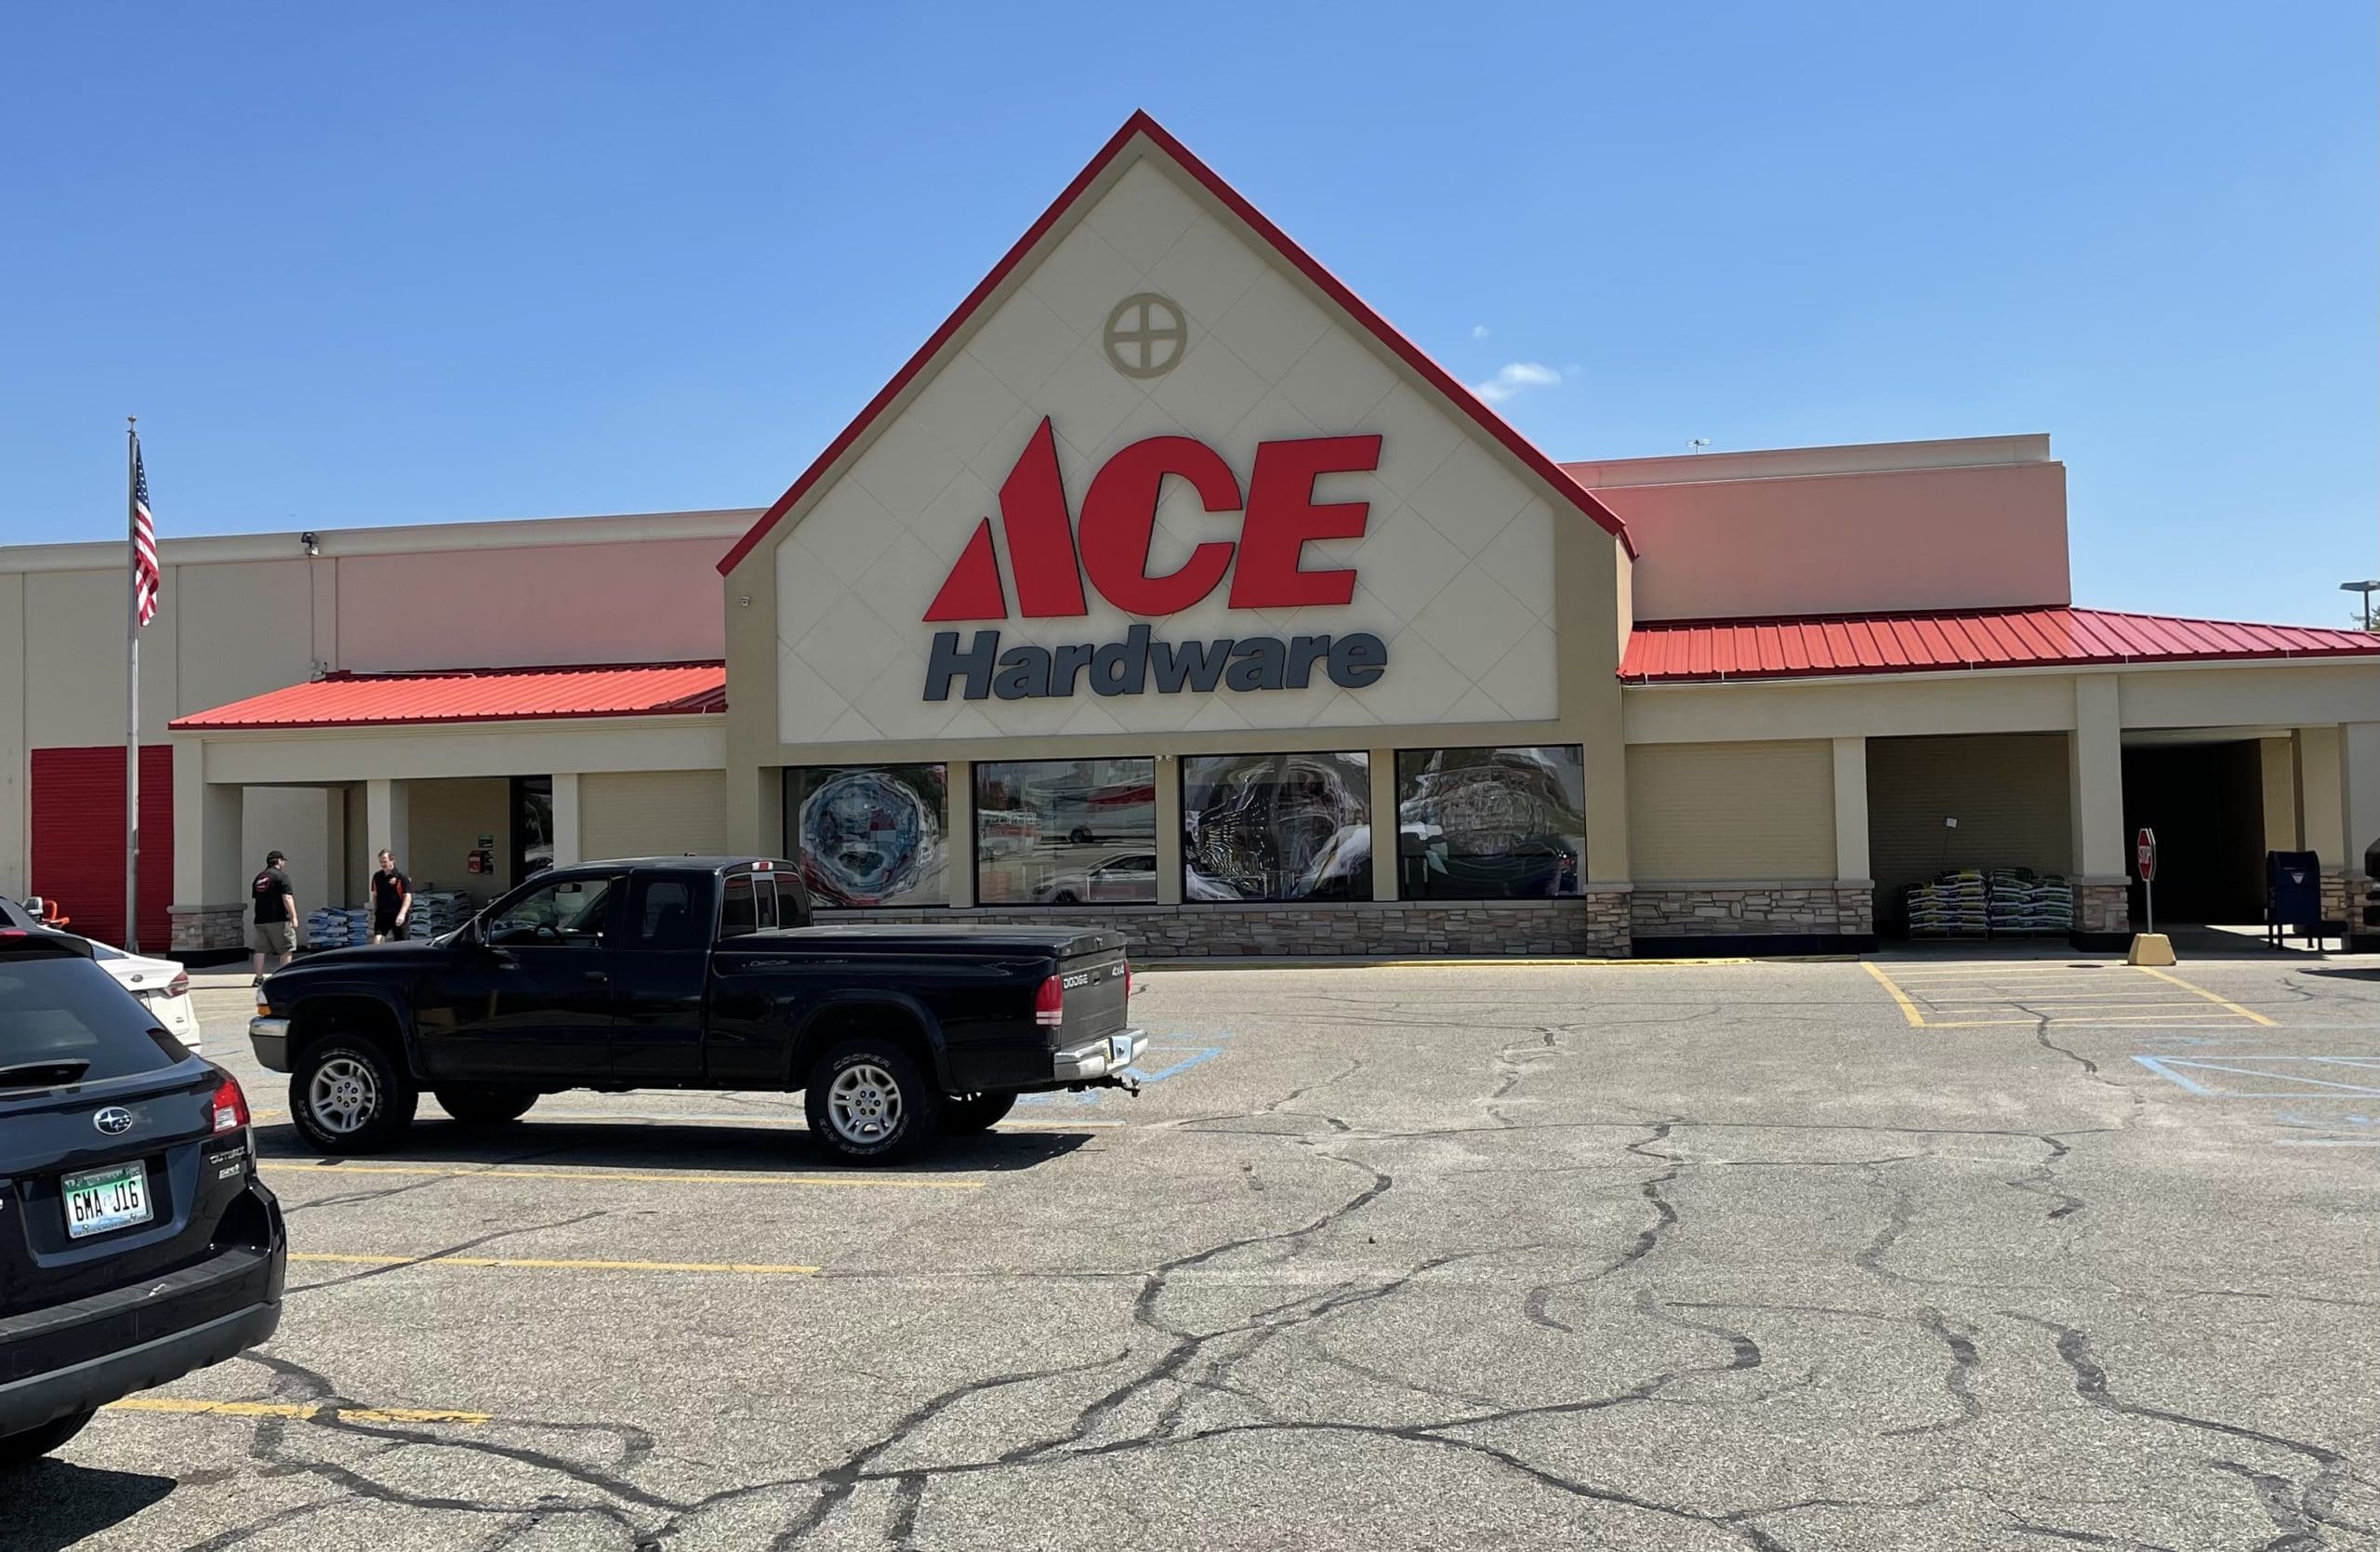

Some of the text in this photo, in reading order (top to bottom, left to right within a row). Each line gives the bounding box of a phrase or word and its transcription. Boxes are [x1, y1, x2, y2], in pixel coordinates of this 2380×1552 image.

[922, 415, 1383, 622] ACE
[922, 624, 1388, 702] Hardware
[2139, 844, 2150, 864] STOP
[1063, 973, 1089, 989] DODGE
[73, 1180, 139, 1222] 6MA J16
